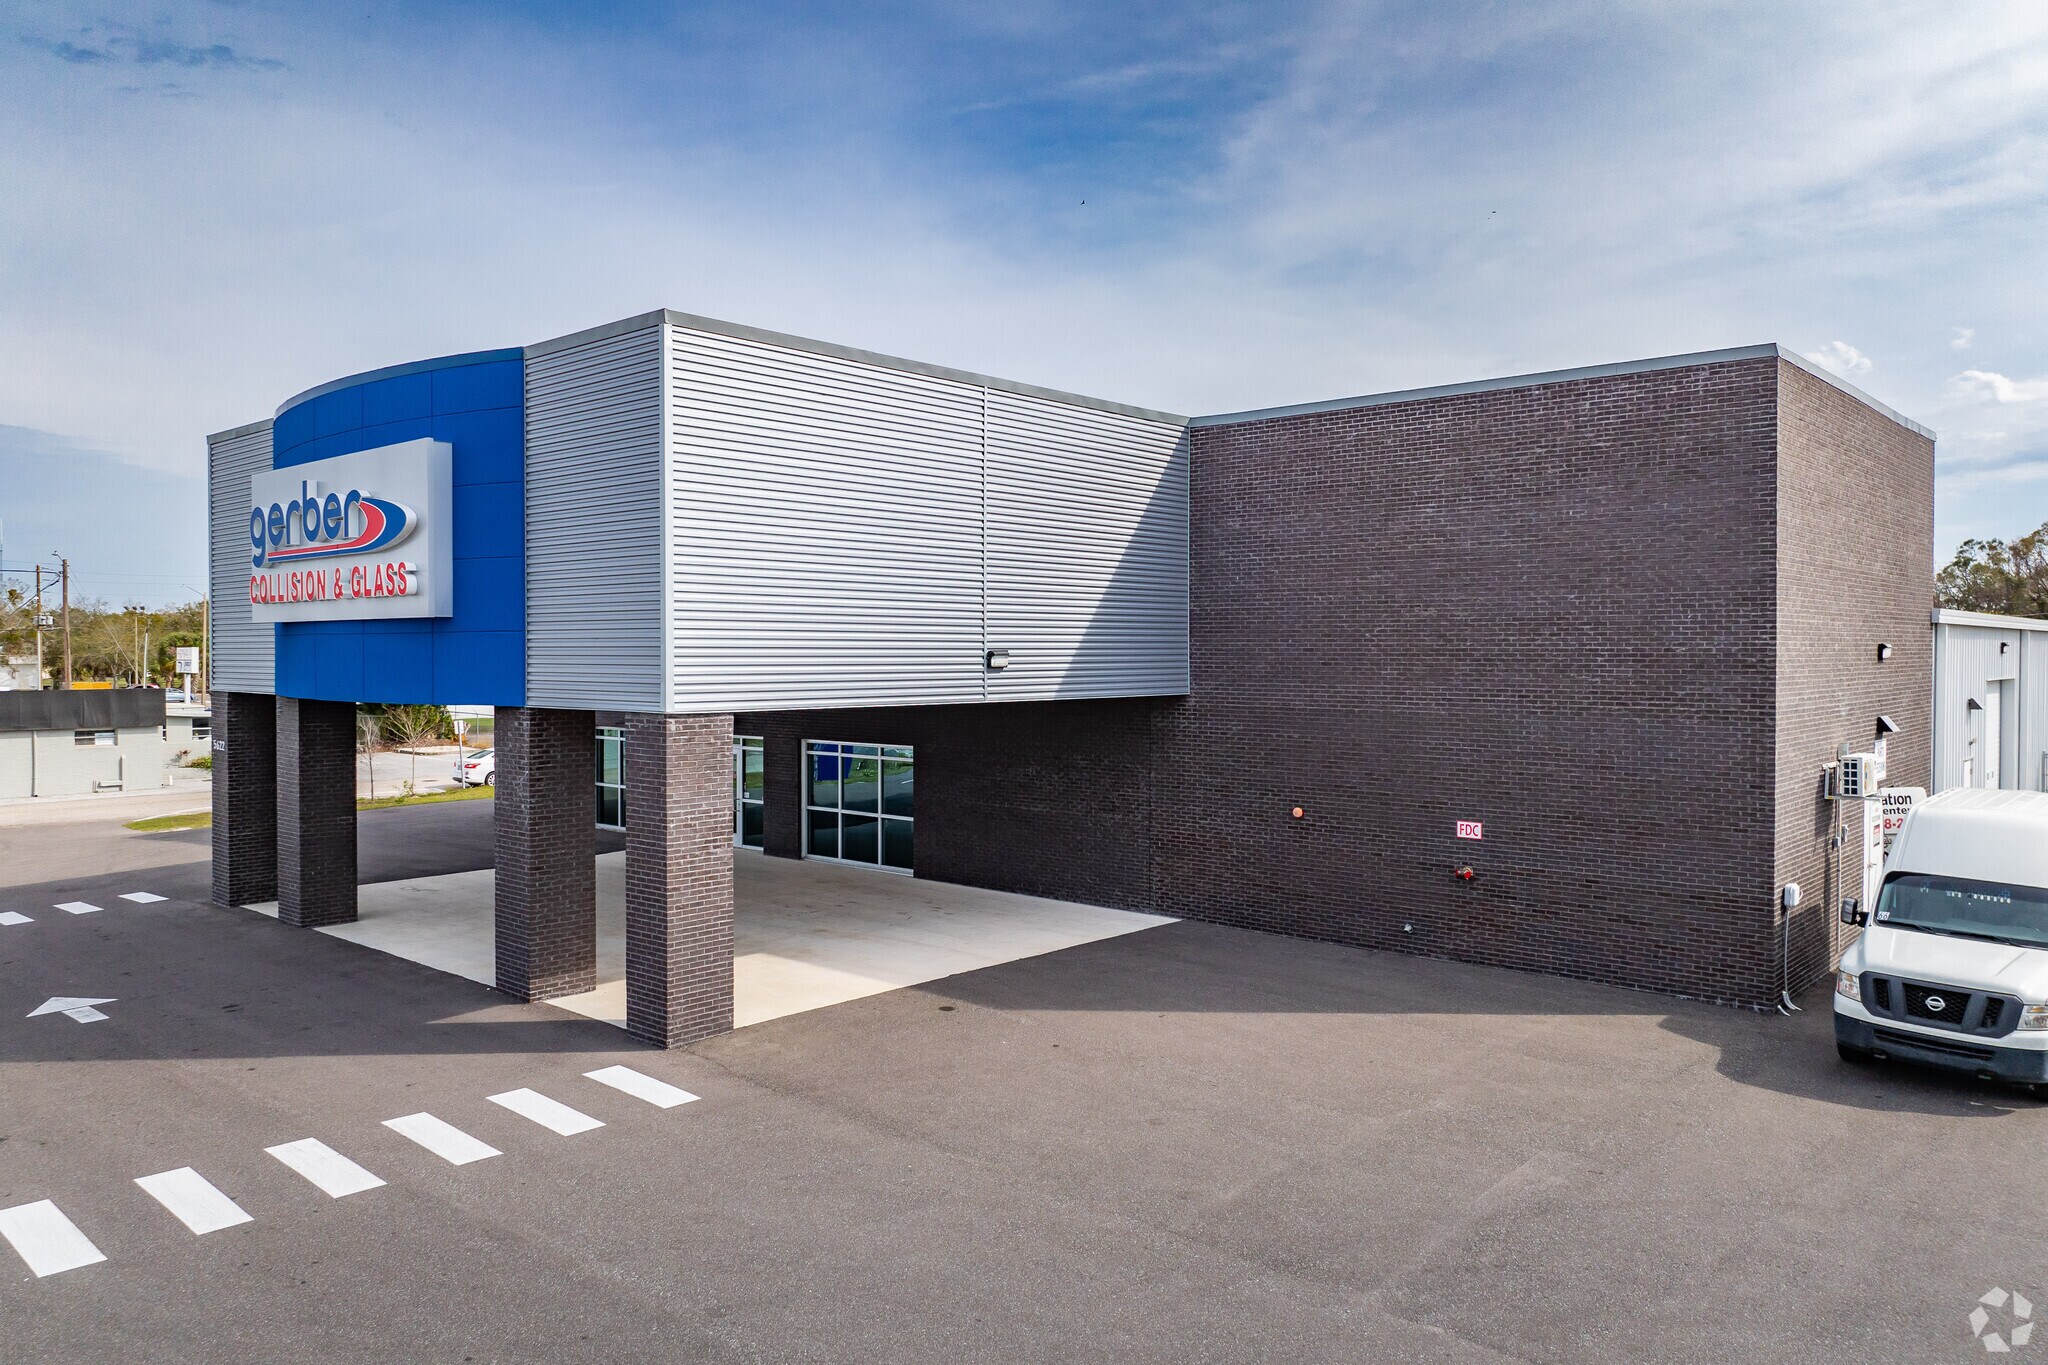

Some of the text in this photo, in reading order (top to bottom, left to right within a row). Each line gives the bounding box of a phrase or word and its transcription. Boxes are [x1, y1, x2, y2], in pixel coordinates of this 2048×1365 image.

[251, 480, 364, 568] gerber
[250, 561, 408, 604] COLLISION & GLASS
[1459, 824, 1479, 837] FDC
